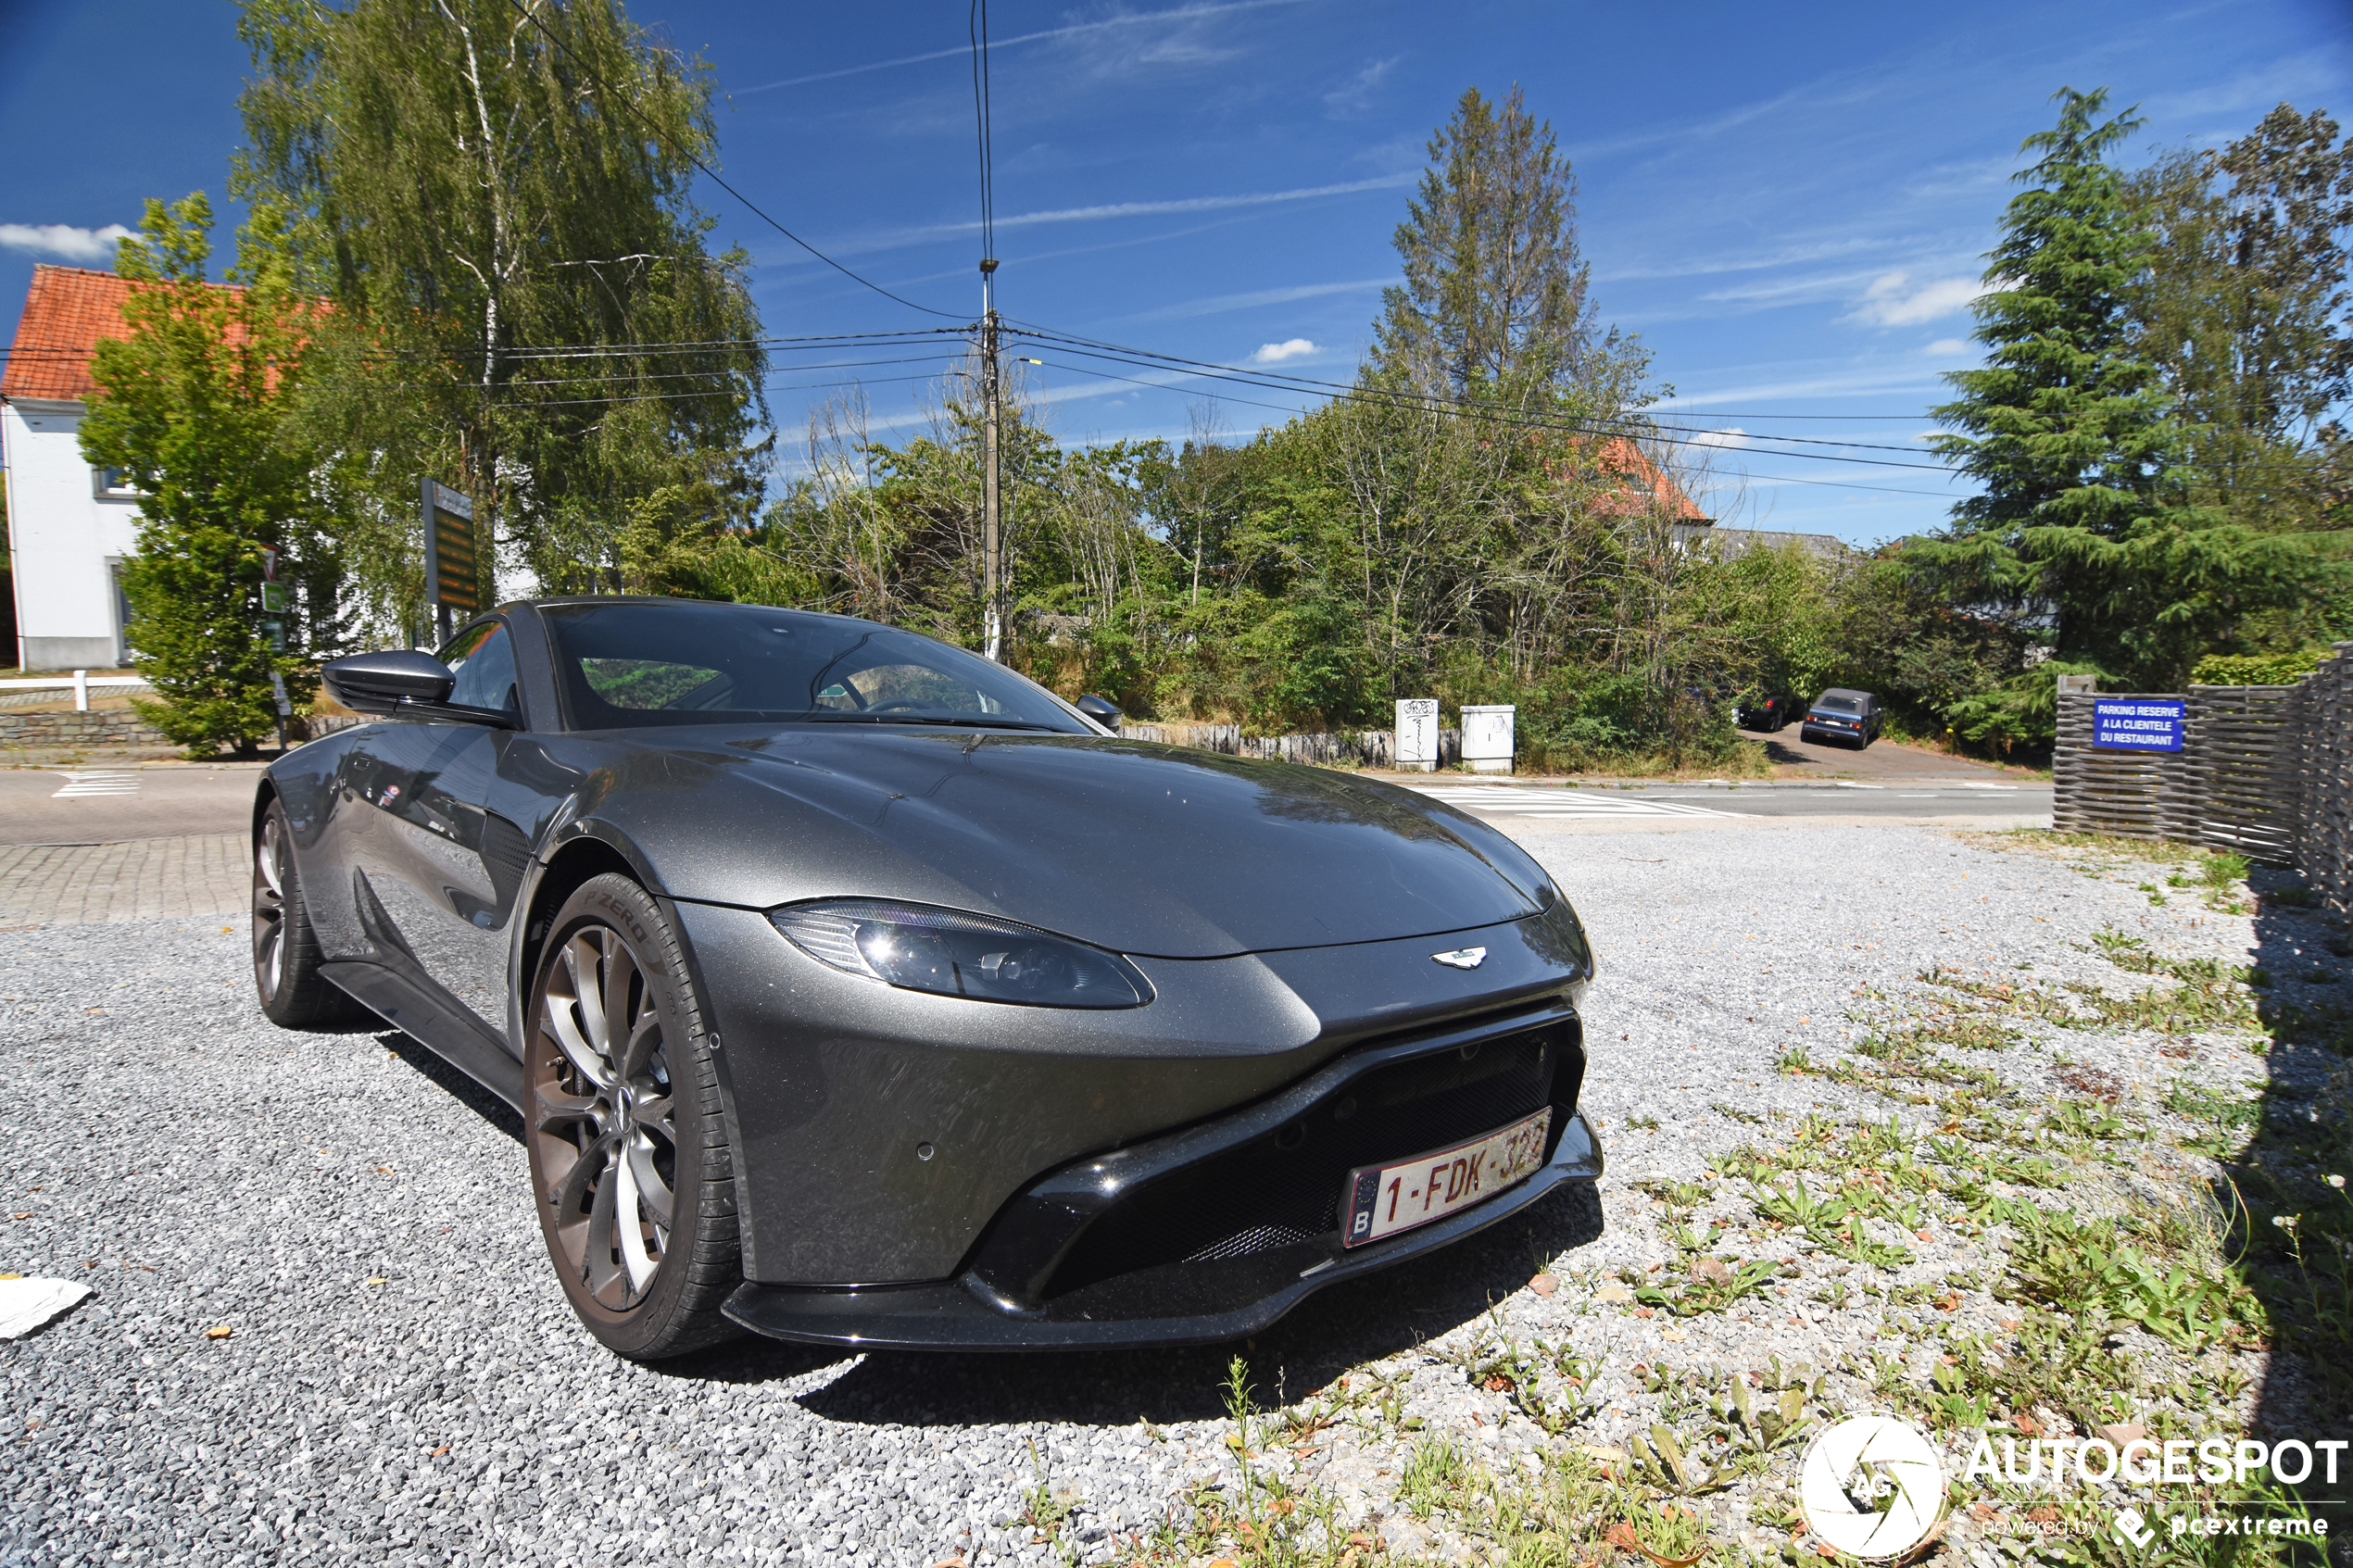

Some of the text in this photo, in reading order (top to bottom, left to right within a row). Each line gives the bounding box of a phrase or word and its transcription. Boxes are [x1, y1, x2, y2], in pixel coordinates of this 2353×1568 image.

[2098, 705, 2180, 717] PARKING RESERVE
[2102, 719, 2172, 731] A LA CLIENTELE
[2100, 732, 2173, 746] DU RESTAURANT
[584, 890, 648, 945] P ZERO
[1387, 1121, 1545, 1223] 1-FDK-322
[1353, 1210, 1369, 1234] B
